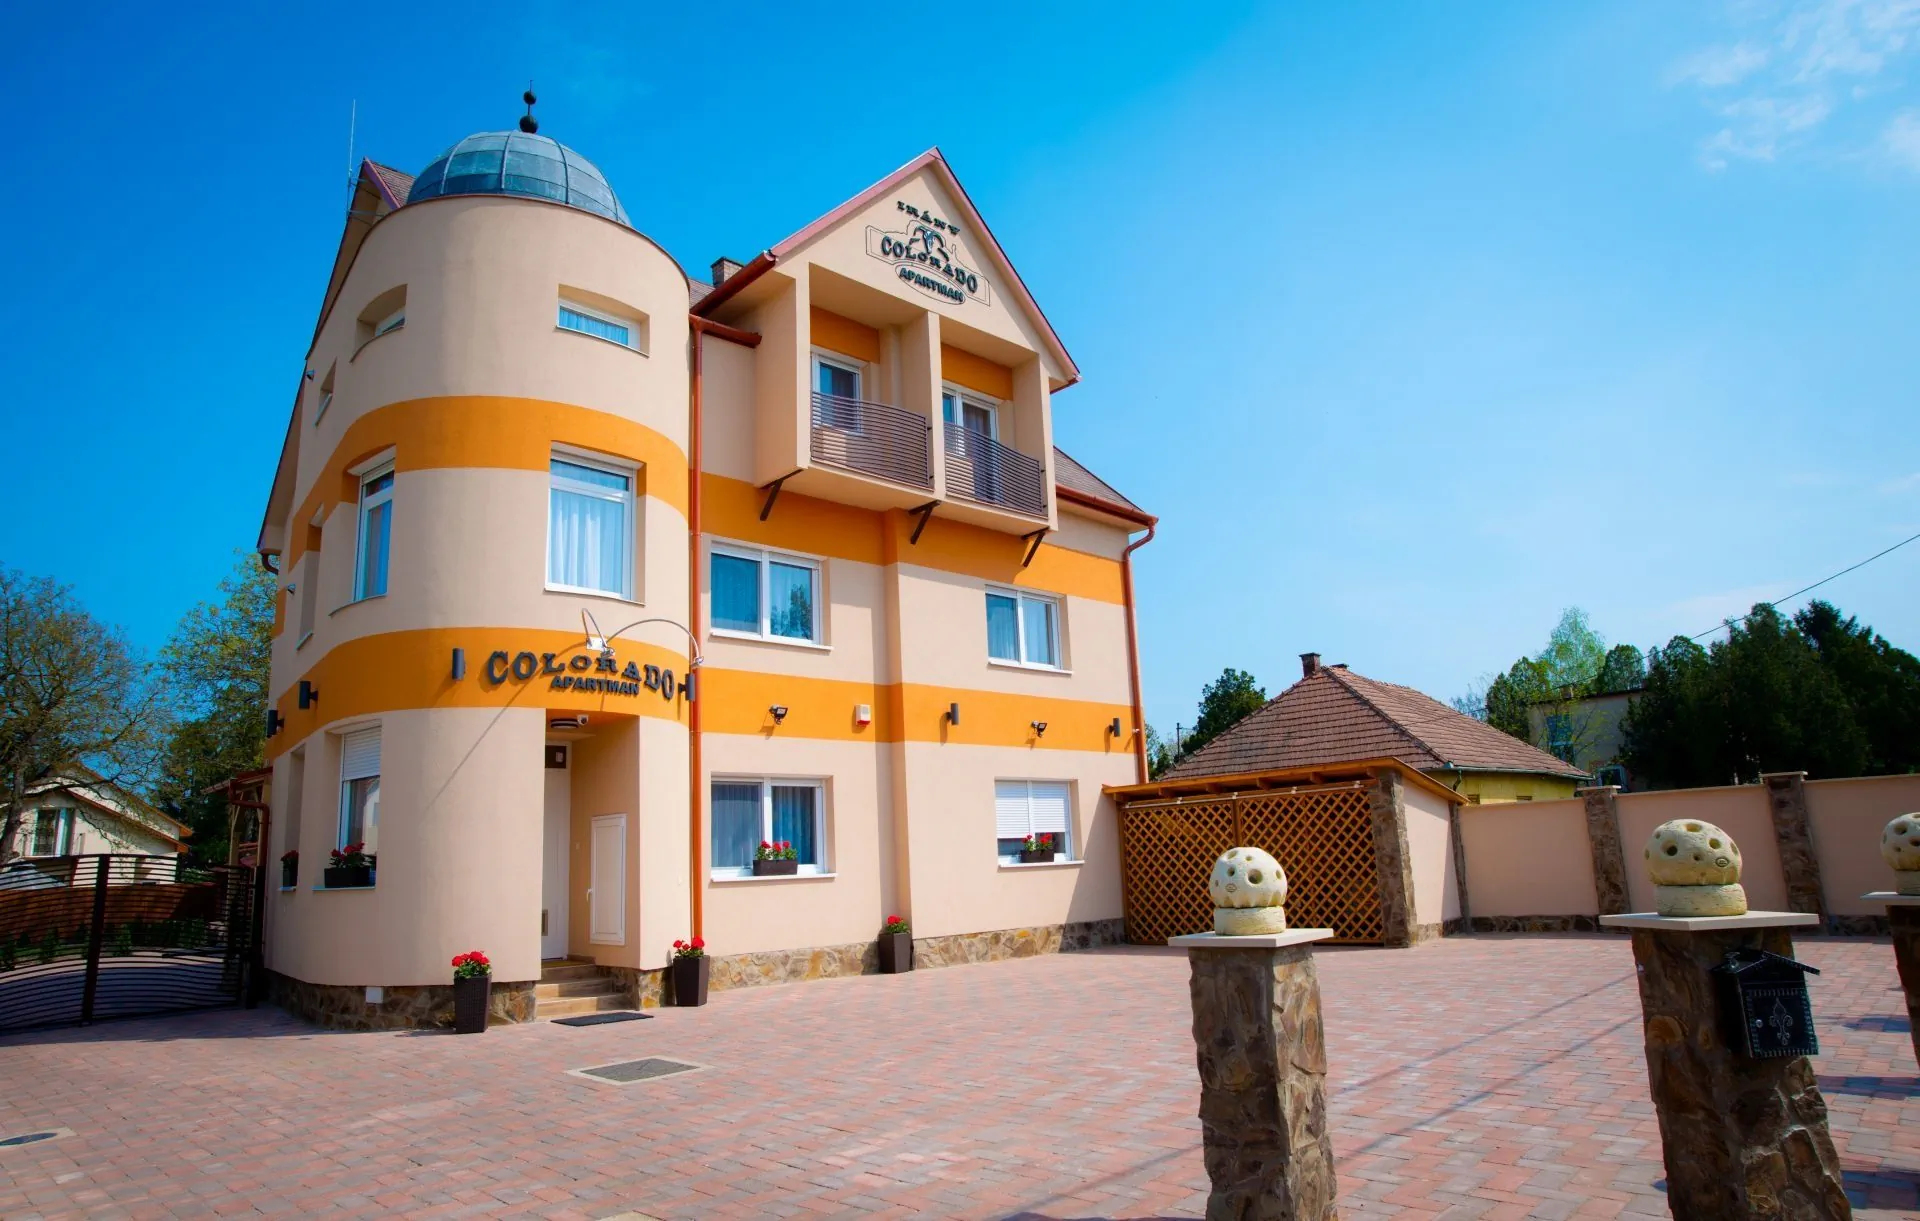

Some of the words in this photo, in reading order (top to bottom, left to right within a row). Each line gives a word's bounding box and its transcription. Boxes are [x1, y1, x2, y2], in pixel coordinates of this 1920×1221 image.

[897, 201, 960, 235] IRÁNY
[881, 236, 978, 293] COLORADO
[899, 267, 964, 302] APARTMAN
[487, 650, 675, 699] COLORADO
[551, 675, 640, 696] APARTMAN
